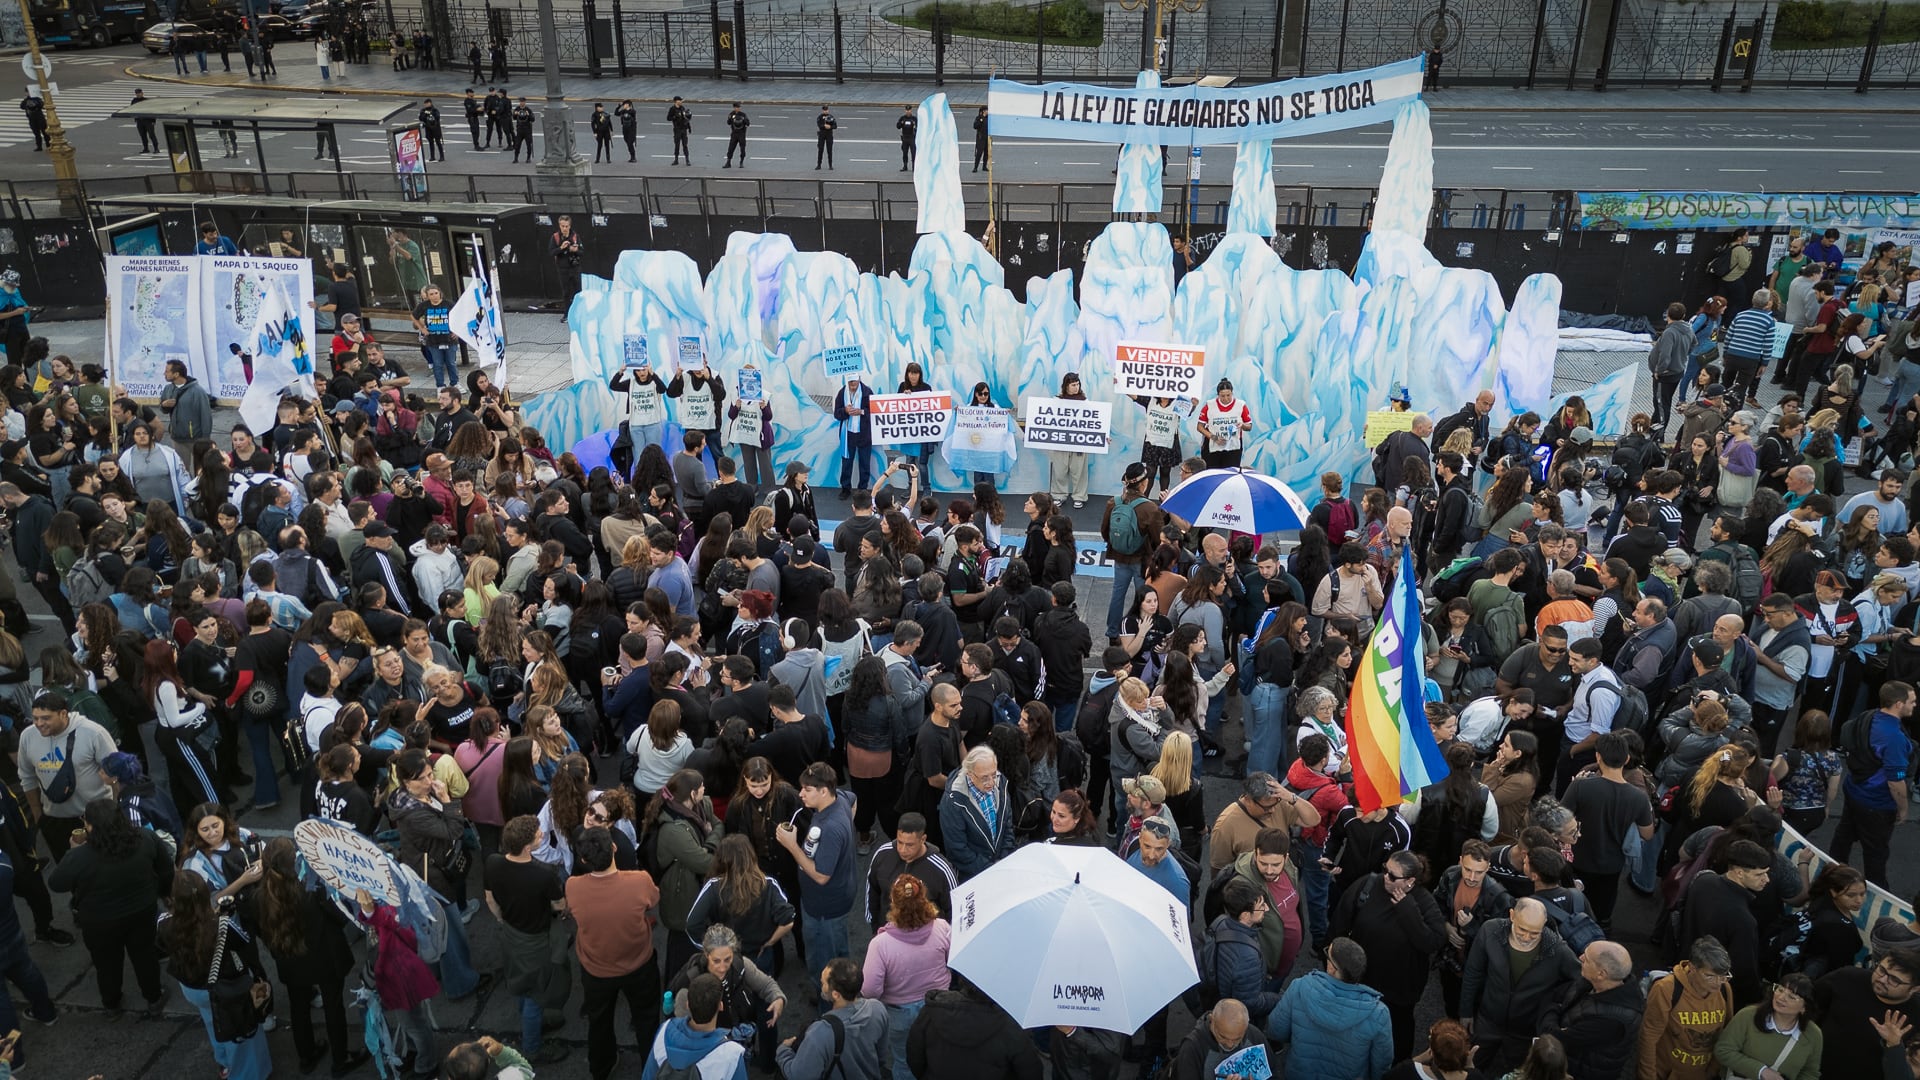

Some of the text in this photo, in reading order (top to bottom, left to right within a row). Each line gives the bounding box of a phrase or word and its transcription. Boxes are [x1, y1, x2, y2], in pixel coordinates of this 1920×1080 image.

[1041, 79, 1376, 128] LA LEY DE GLACIARES NO SE TOCA
[1643, 193, 1750, 220] BOSQUES
[1752, 194, 1775, 220] Y
[214, 260, 241, 269] MAPA
[262, 262, 299, 271] SAQUEO
[837, 346, 857, 354] PATRIA
[843, 352, 862, 360] VENDE
[1126, 347, 1193, 365] VENDEN
[832, 364, 859, 374] DEFIENDE
[1122, 362, 1196, 379] NUESTRO
[1126, 376, 1189, 393] FUTURO
[876, 398, 941, 413] VENDEN
[1038, 406, 1099, 419] LA LEY DE
[875, 411, 945, 426] NUESTRO
[1034, 416, 1101, 430] GLACIARES
[1149, 411, 1173, 421] POPULAR
[881, 425, 941, 439] FUTURO
[1029, 430, 1103, 445] NO SE TOCA
[323, 842, 375, 872] HAGAN
[328, 863, 384, 890] TRABAJO
[1053, 983, 1105, 1004] LA CAMPORA
[1678, 1009, 1725, 1025] HARRY
[1671, 1048, 1711, 1066] STYL
